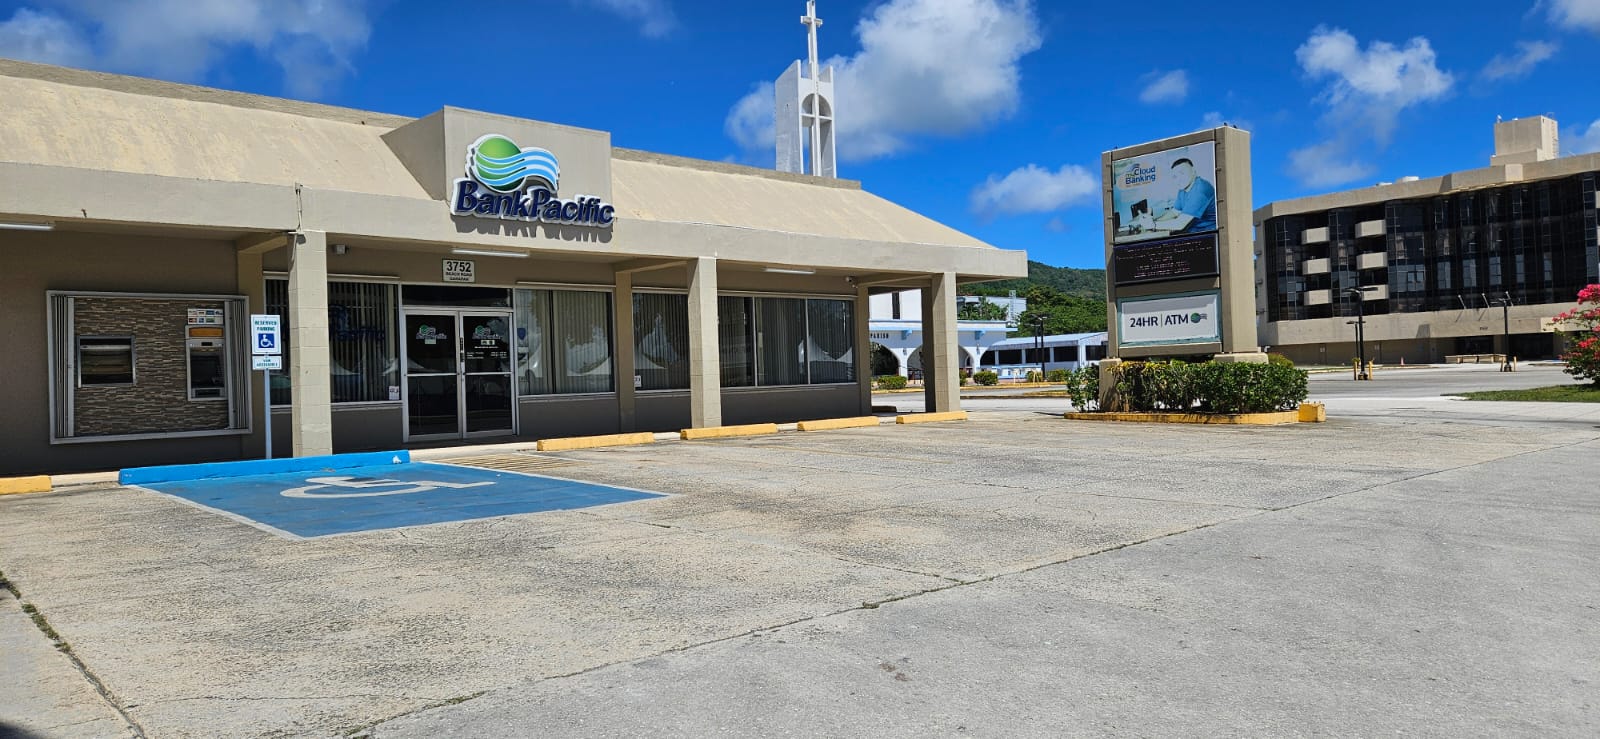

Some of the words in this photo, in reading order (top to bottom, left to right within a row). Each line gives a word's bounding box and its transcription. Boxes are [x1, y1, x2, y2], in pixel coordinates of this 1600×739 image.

[1134, 165, 1156, 176] Cloud
[1125, 174, 1156, 185] Banking
[455, 180, 615, 225] BankPacific
[446, 261, 472, 273] 3752
[1130, 316, 1158, 328] 24HR
[1164, 313, 1189, 326] ATM
